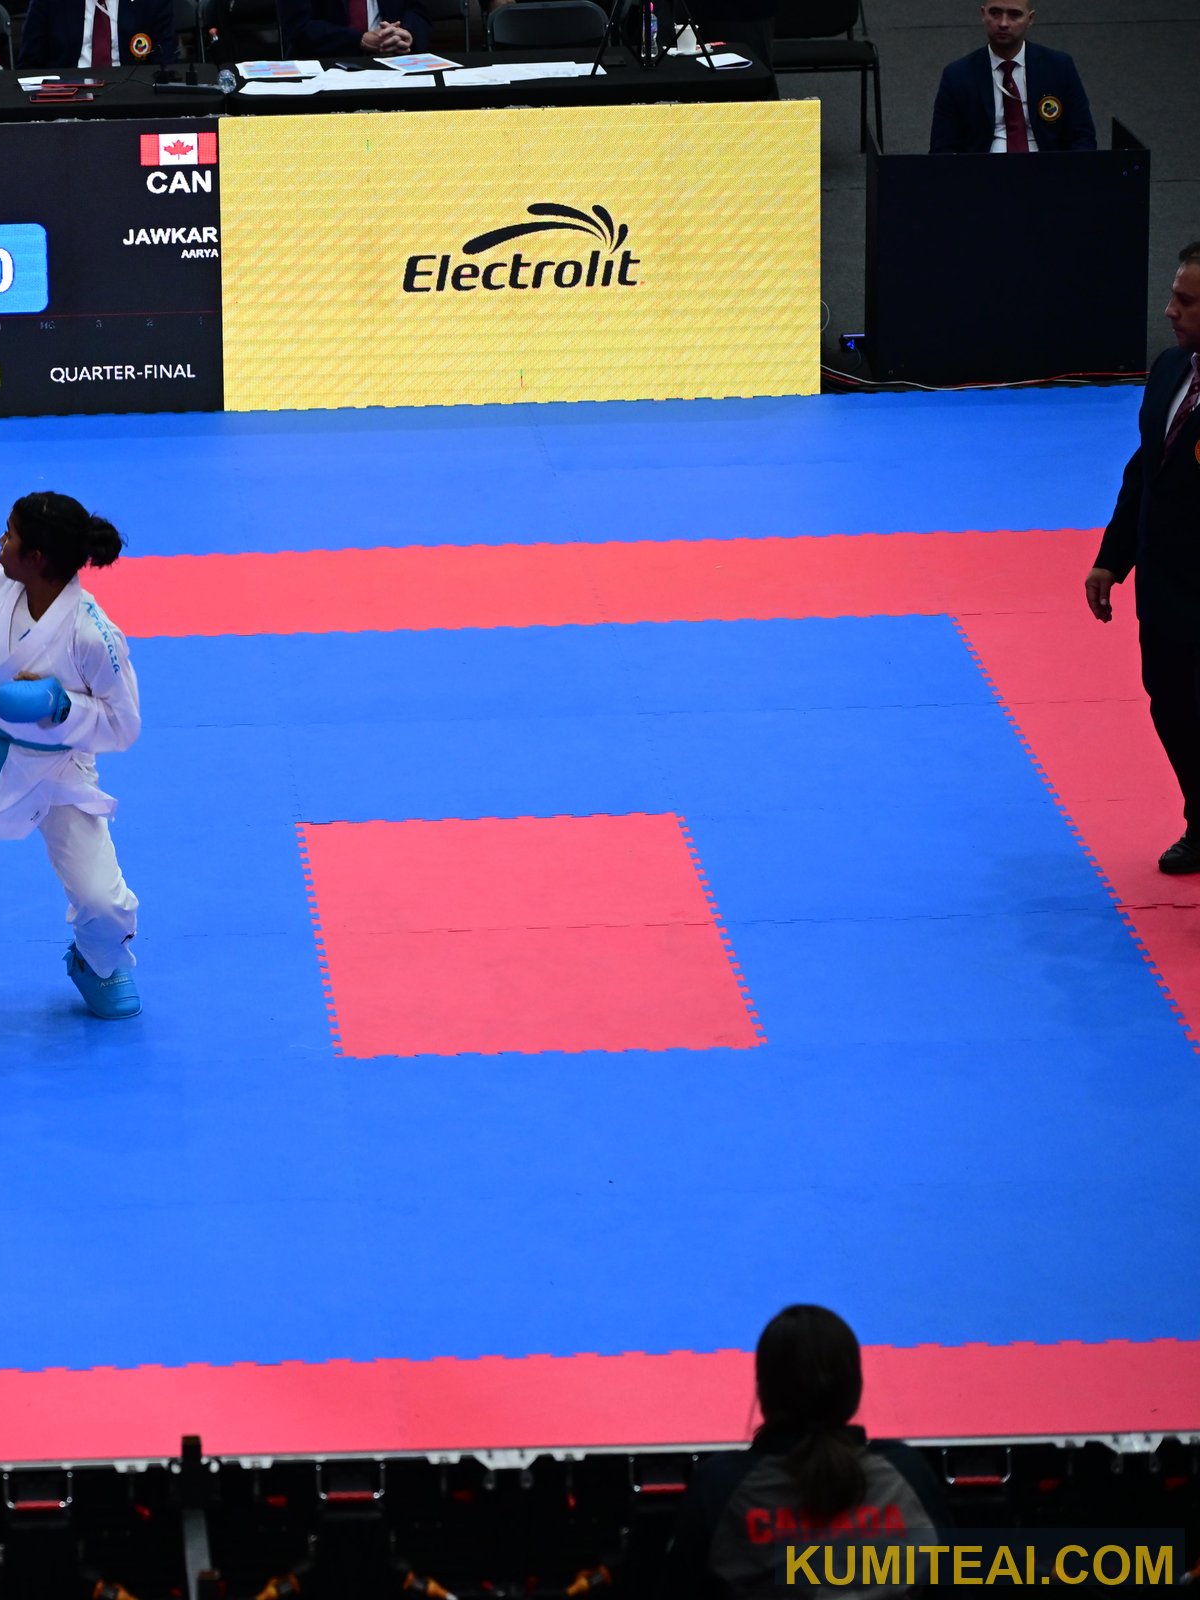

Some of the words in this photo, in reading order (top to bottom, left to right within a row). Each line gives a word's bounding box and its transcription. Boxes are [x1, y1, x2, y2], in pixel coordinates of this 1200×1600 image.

[146, 170, 212, 194] CAN
[122, 226, 219, 245] JAWKAR
[180, 248, 219, 259] AARYA
[402, 250, 641, 293] Electrolit
[50, 364, 196, 383] QUARTER-FINAL
[746, 1503, 906, 1544] CAADA
